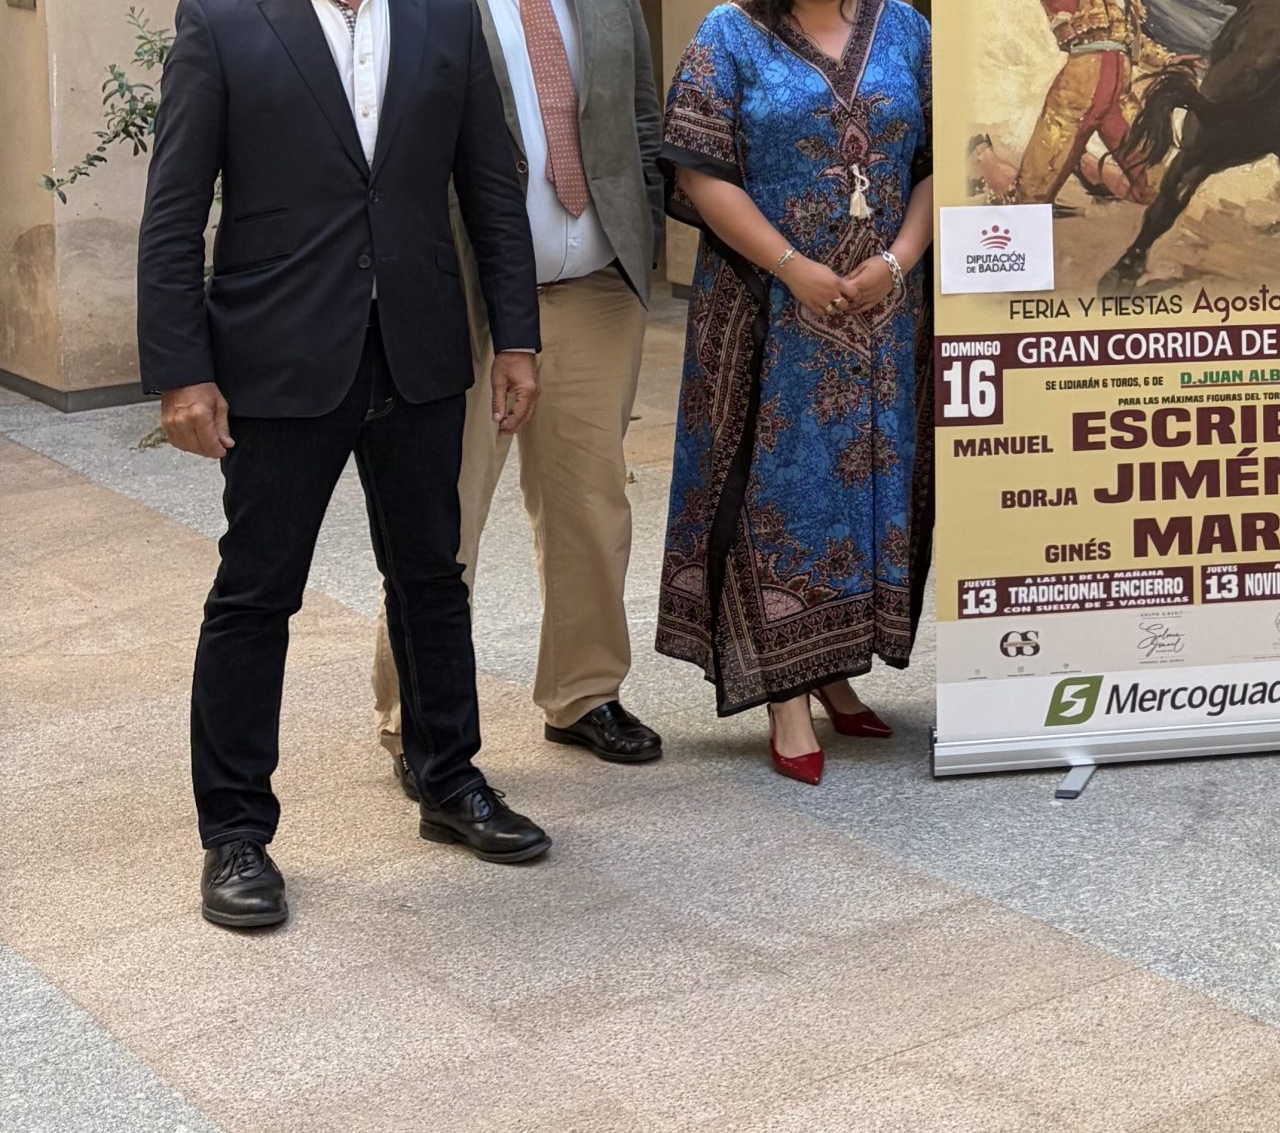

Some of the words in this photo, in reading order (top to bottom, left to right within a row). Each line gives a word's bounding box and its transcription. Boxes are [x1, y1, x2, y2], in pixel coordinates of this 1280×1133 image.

[966, 251, 1026, 264] DIPUTACIÓN
[978, 262, 1026, 273] BADAJOZ
[1009, 299, 1070, 320] FERIA
[1078, 298, 1095, 317] Y
[1102, 294, 1183, 316] FIESTAS
[941, 340, 1001, 357] DOMINGO
[1017, 335, 1100, 364] GRAN
[1107, 330, 1234, 360] CORRIDA
[1241, 329, 1278, 356] DE
[943, 359, 996, 418] 16
[1045, 380, 1057, 390] SE
[1059, 376, 1100, 389] LIDIARÁN
[1102, 379, 1108, 388] 6
[1110, 377, 1142, 389] TOROS,
[1143, 377, 1150, 387] 6
[1152, 376, 1164, 386] DE
[1118, 397, 1141, 406] PARA
[1143, 396, 1159, 405] LAS
[1161, 393, 1204, 404] MÁXIMAS
[1206, 393, 1243, 402] FIGURAS
[1245, 392, 1260, 401] DEL
[953, 435, 1054, 458] MANUEL
[1001, 487, 1078, 509] BORJA
[1044, 538, 1112, 563] GINÉS
[1206, 565, 1238, 573] JUEVES
[963, 579, 997, 588] JUEVES
[1008, 581, 1108, 605] TRADICIONAL
[1111, 576, 1184, 598] ENCIERRO
[1205, 574, 1239, 600] 13
[962, 588, 998, 615] 13
[1036, 603, 1081, 612] SUELTA
[1119, 595, 1190, 606] VAQUILLAS
